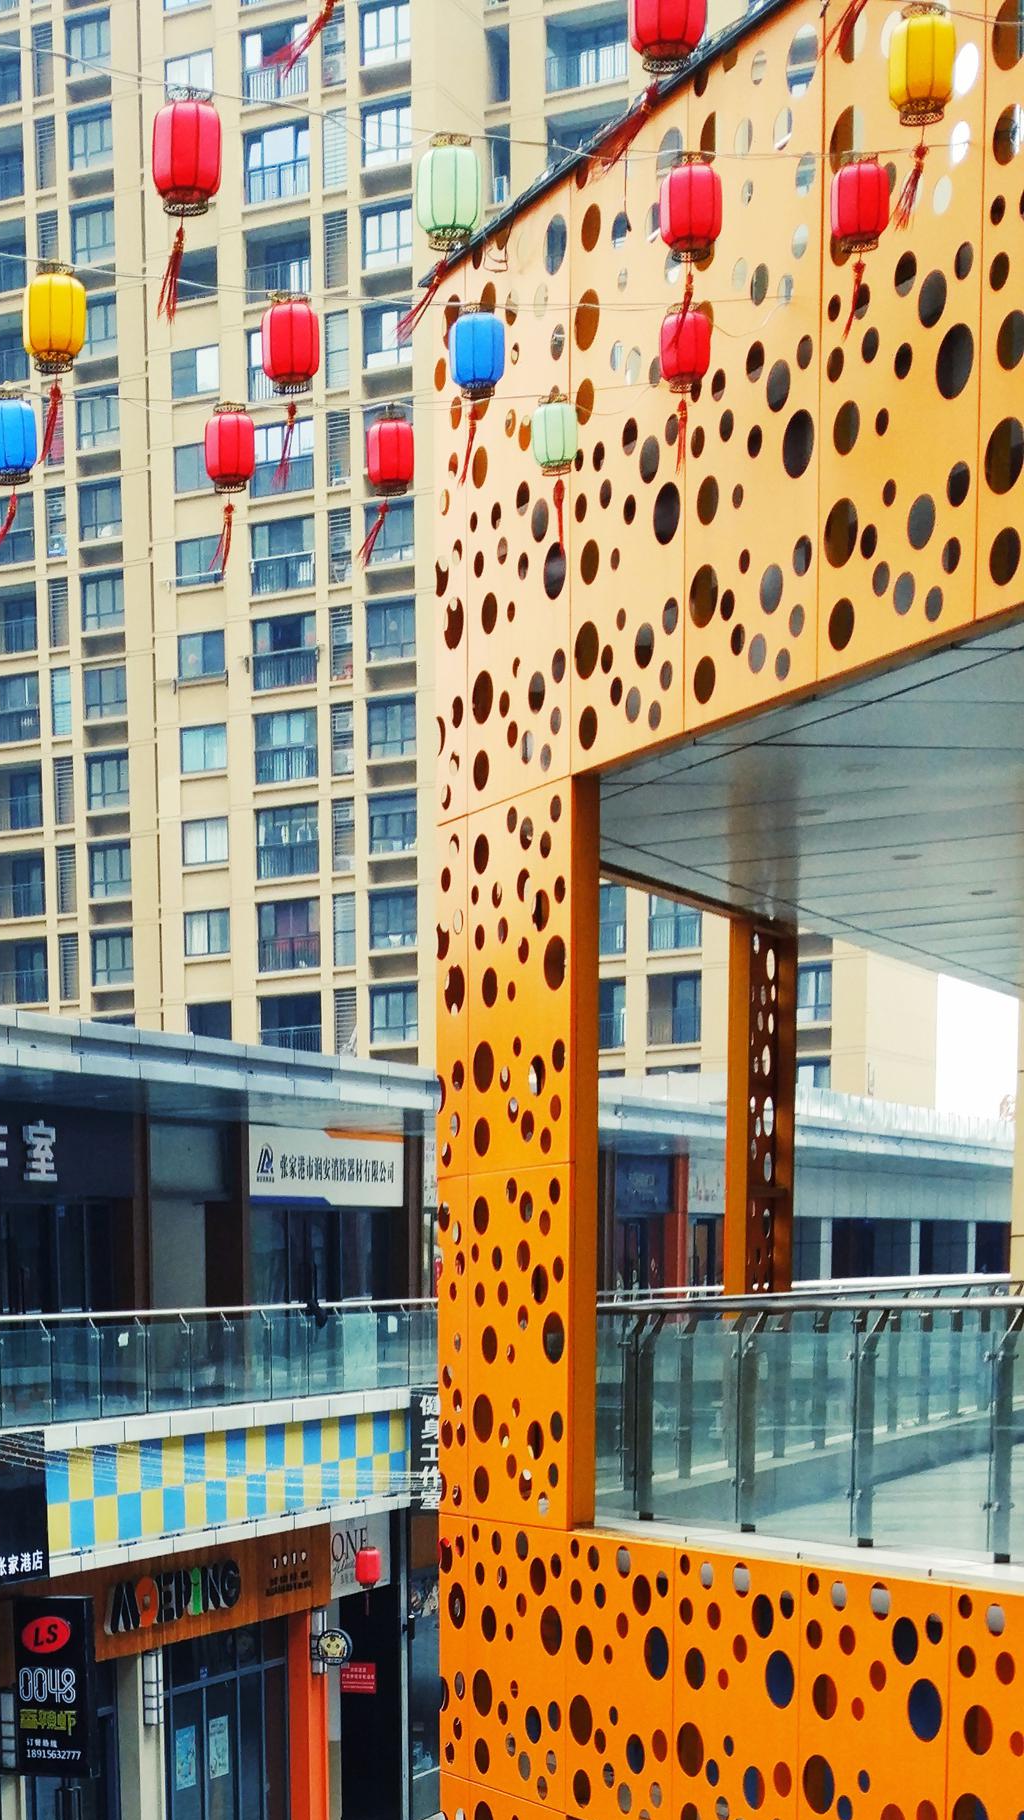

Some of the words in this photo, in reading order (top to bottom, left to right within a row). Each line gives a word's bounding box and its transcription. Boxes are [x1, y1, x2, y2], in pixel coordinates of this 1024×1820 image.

[279, 1152, 395, 1184] 张家港市润安消防器材有限公司
[33, 1623, 59, 1648] LS
[18, 1667, 77, 1704] 0048
